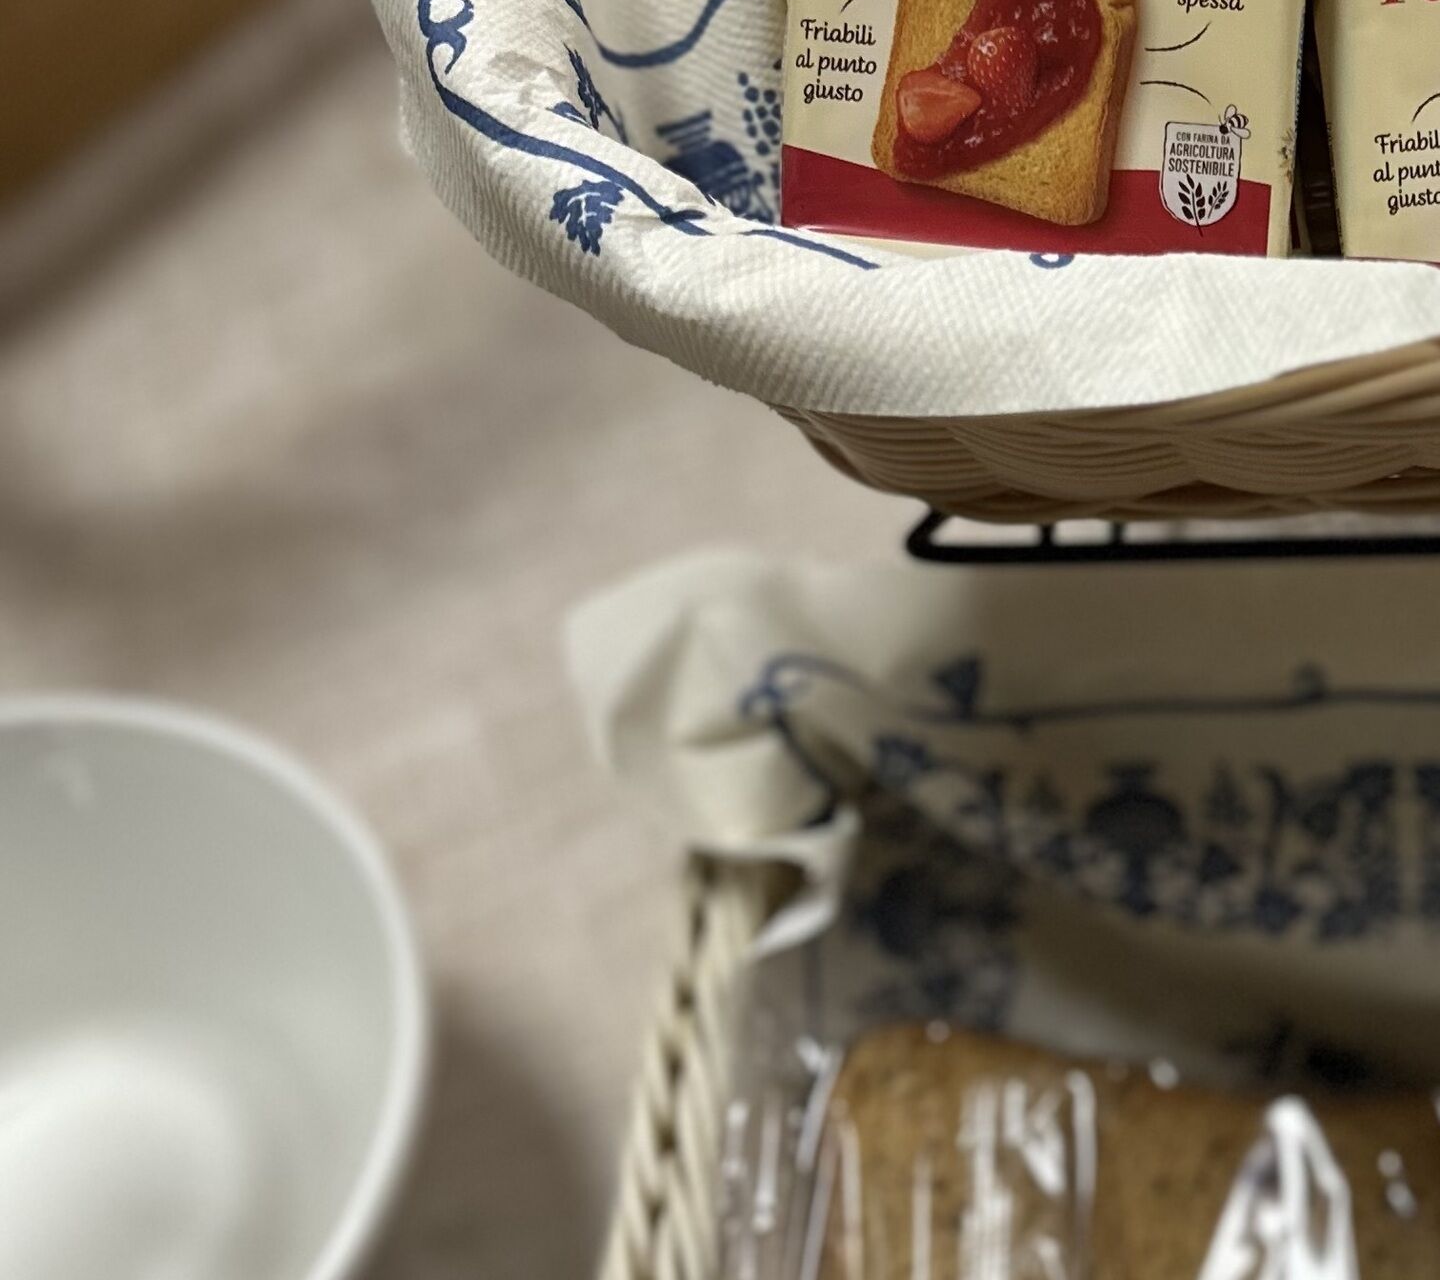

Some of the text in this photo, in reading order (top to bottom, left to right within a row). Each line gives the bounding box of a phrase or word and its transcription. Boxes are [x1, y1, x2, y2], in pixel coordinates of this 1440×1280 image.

[800, 18, 876, 47] Friabili
[795, 51, 877, 77] al punto
[803, 80, 864, 104] giusto
[1176, 131, 1230, 145] CON FARINA DA
[1170, 143, 1235, 160] AGRICOLTURA
[1168, 158, 1234, 177] SOSTENIBILE
[1372, 161, 1394, 182] al
